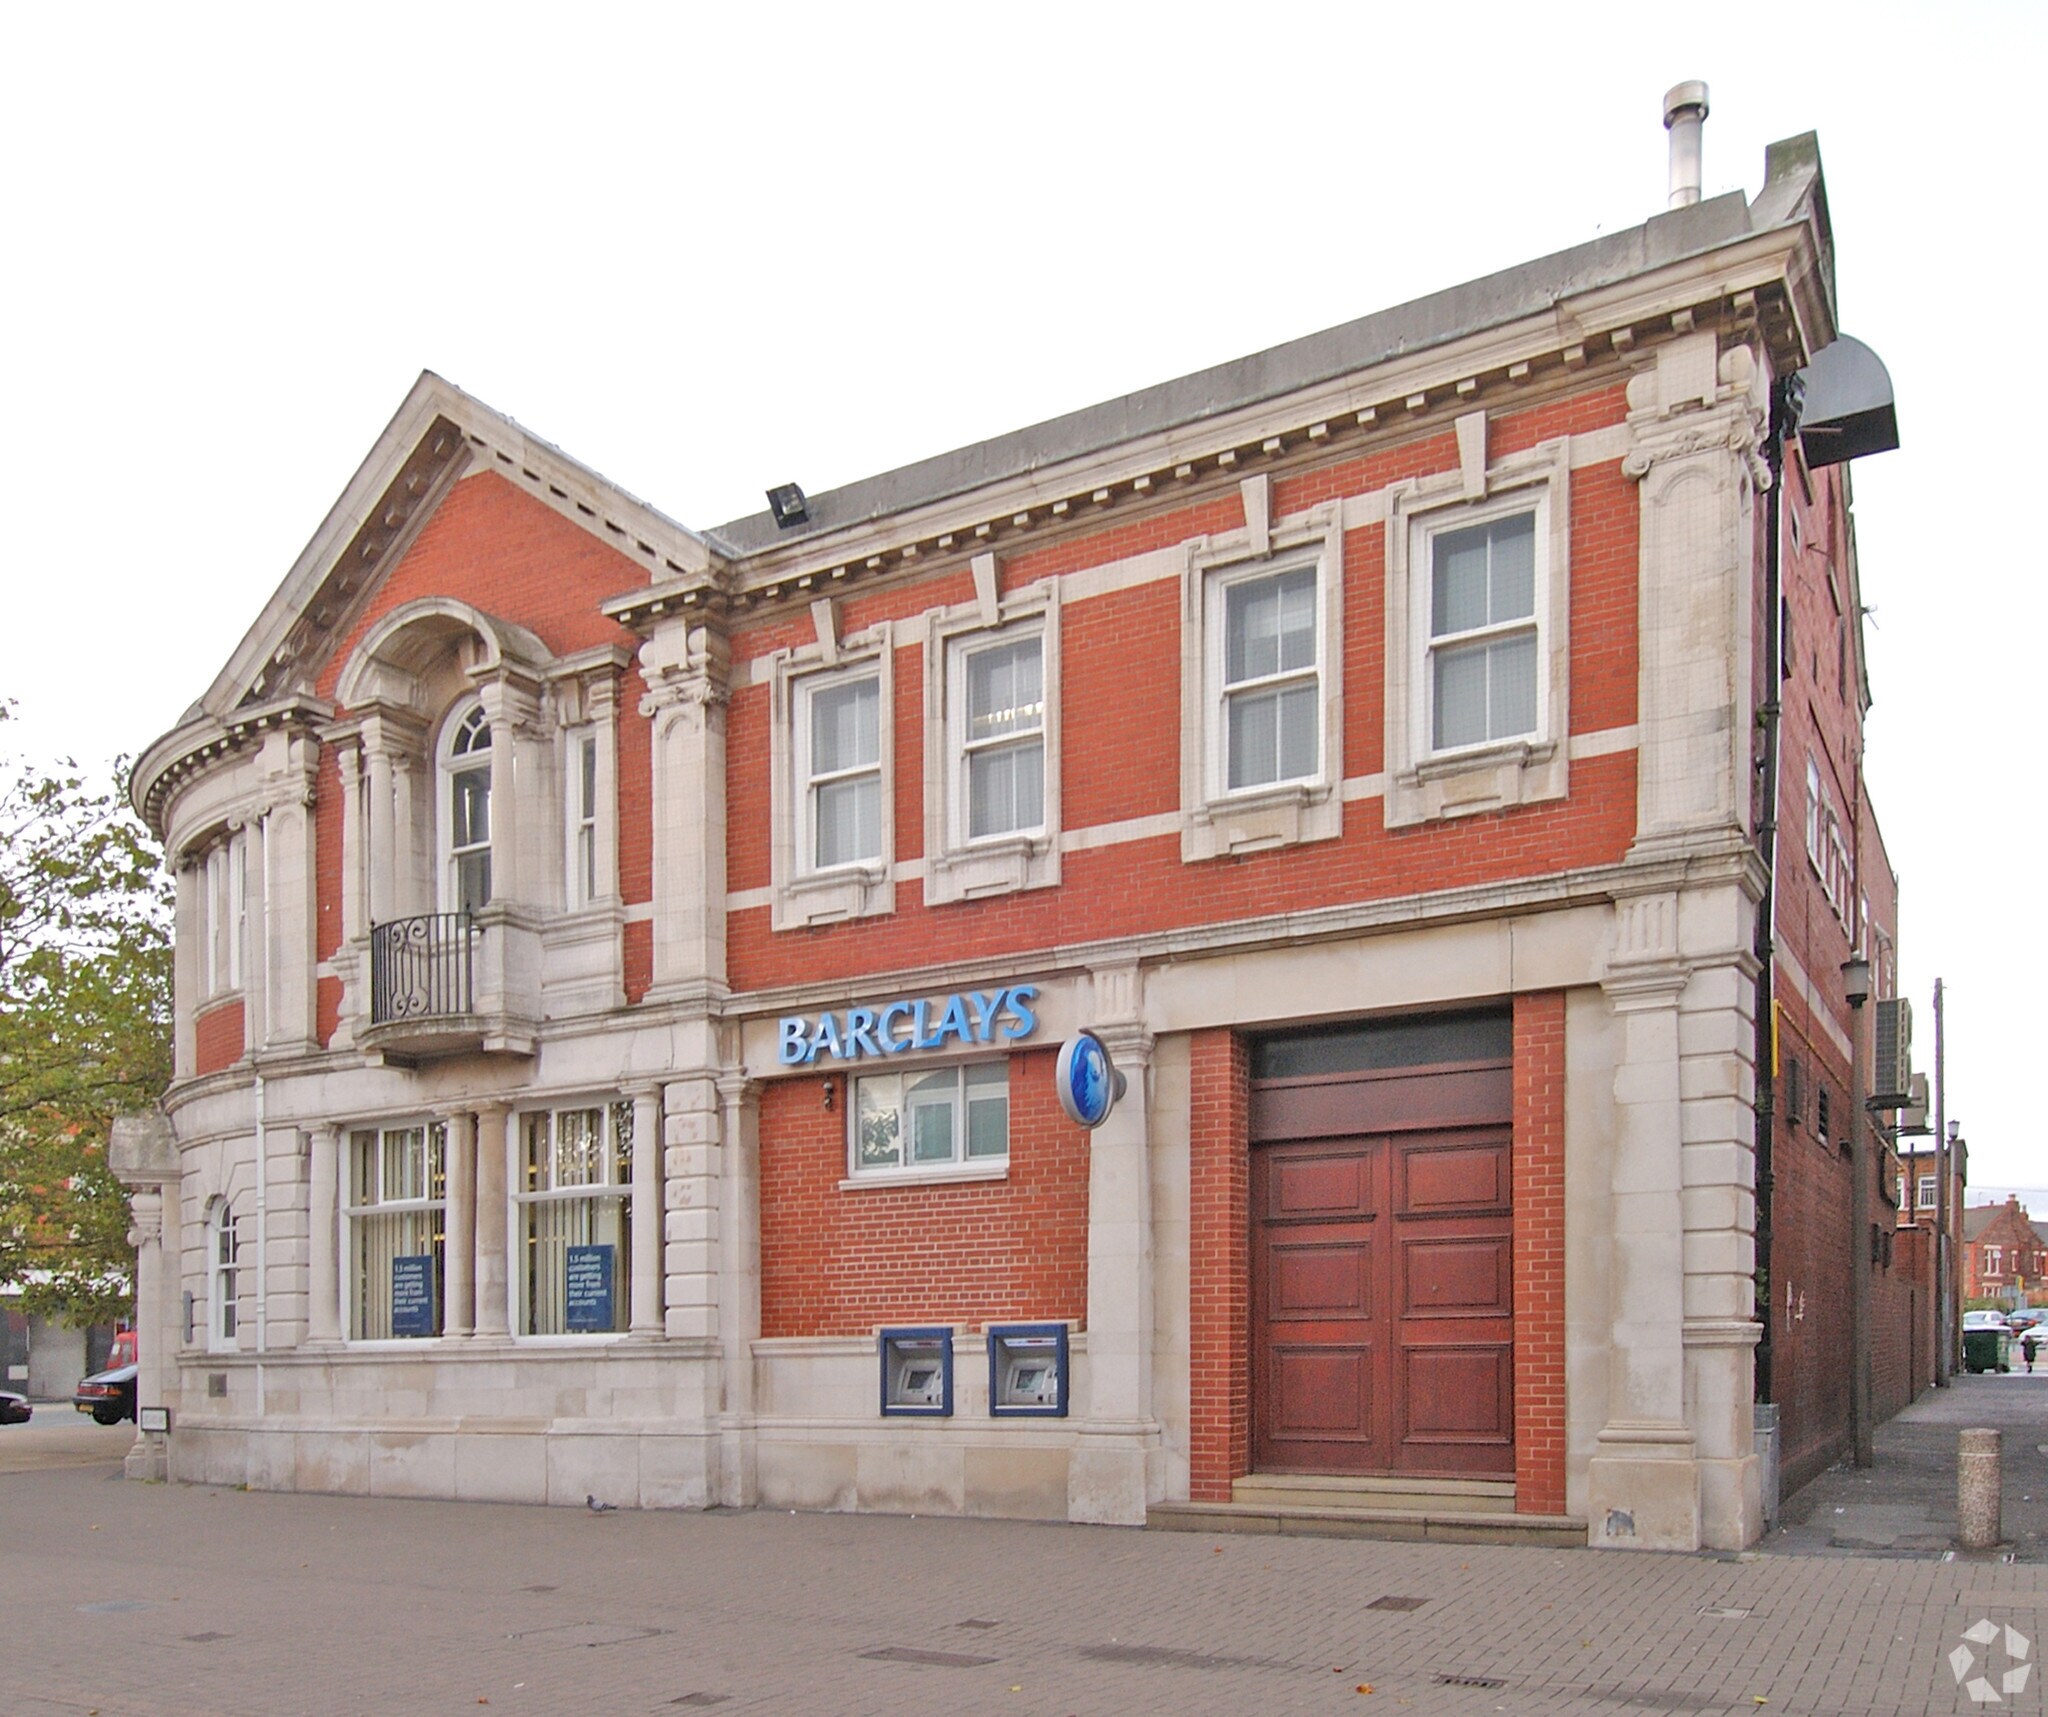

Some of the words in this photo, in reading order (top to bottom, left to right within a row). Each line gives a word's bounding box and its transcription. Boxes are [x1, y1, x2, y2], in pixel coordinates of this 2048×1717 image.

[778, 984, 1038, 1066] BARCLAYS
[580, 1254, 602, 1262] million
[404, 1264, 423, 1272] million
[568, 1264, 600, 1272] customers
[394, 1273, 423, 1281] customers
[580, 1272, 602, 1281] getting
[586, 1280, 601, 1288] from
[584, 1289, 607, 1297] current
[408, 1297, 428, 1305] current
[569, 1298, 596, 1306] accounts
